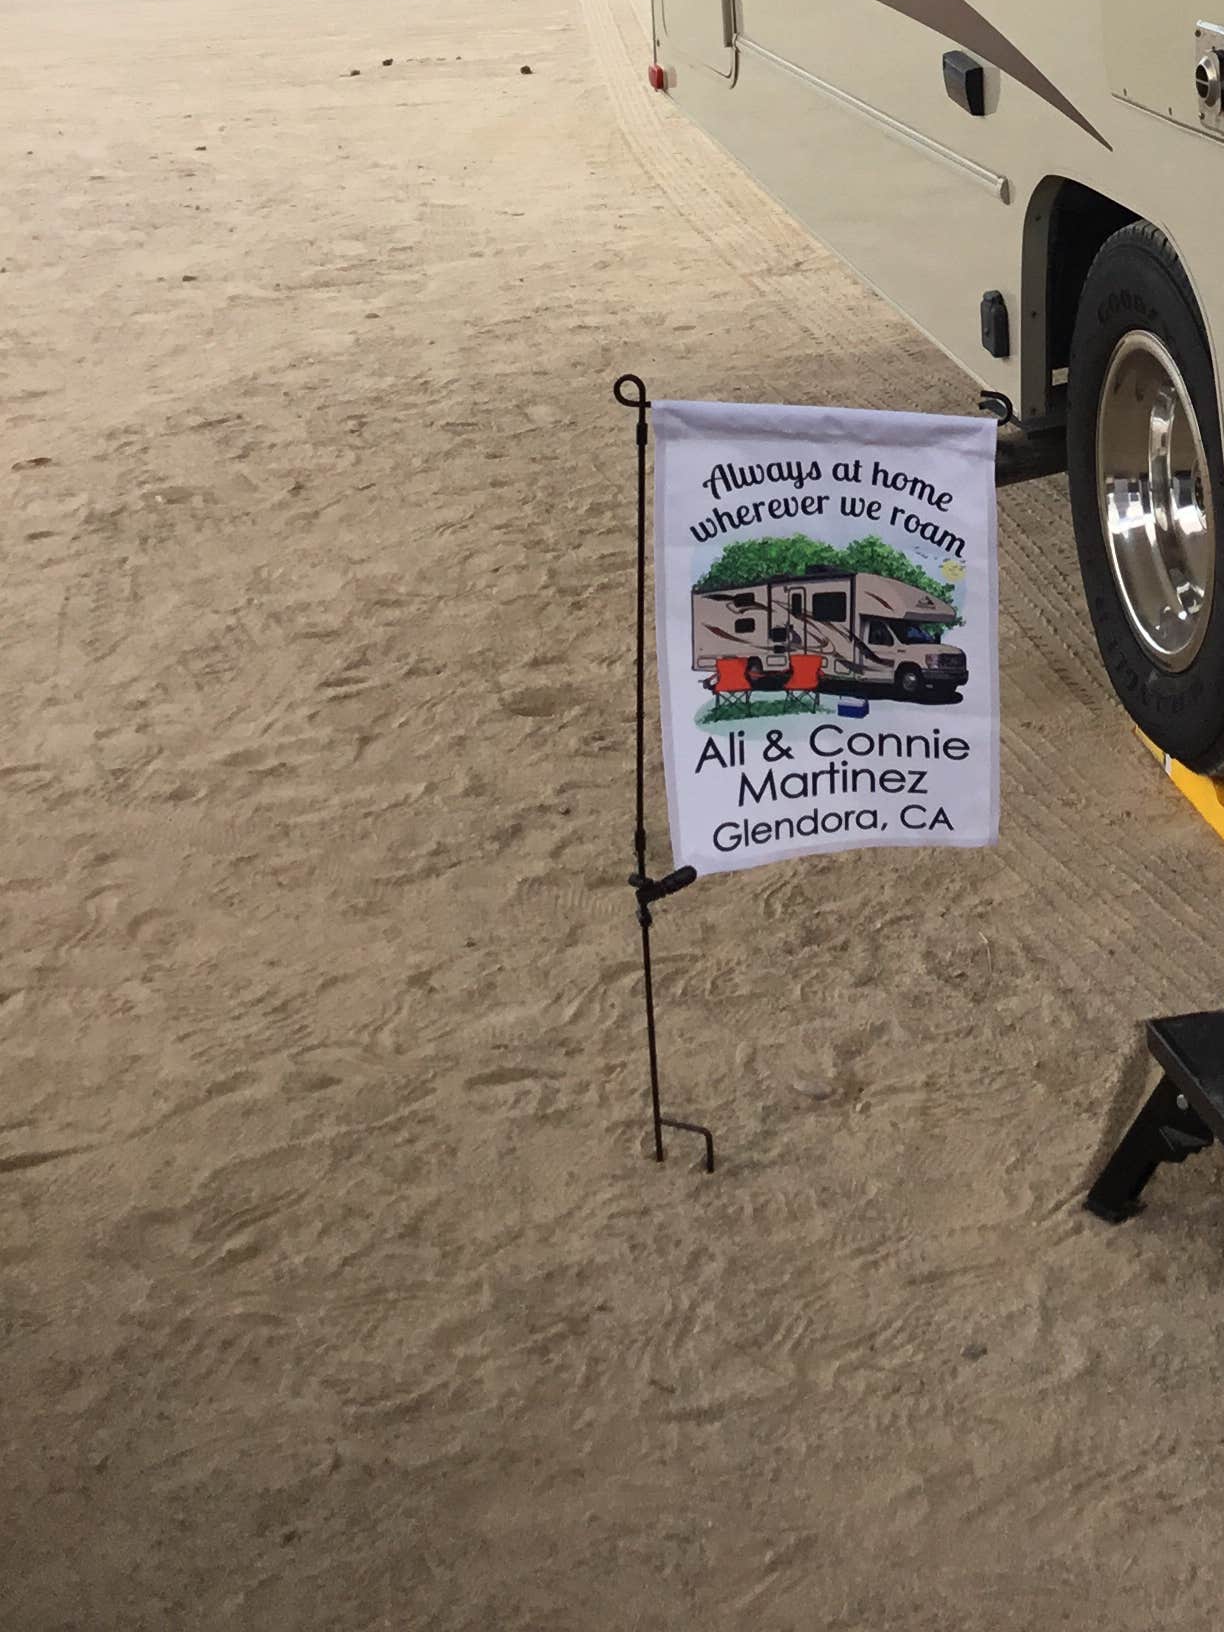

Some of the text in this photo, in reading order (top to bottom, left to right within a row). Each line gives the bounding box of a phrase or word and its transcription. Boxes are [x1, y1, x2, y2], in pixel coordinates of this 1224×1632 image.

[703, 460, 953, 512] Always at home
[690, 495, 966, 558] wherever we roam
[695, 724, 970, 774] Ali & Connie
[738, 760, 928, 807] Martinez
[713, 804, 954, 852] Glendora, CA
